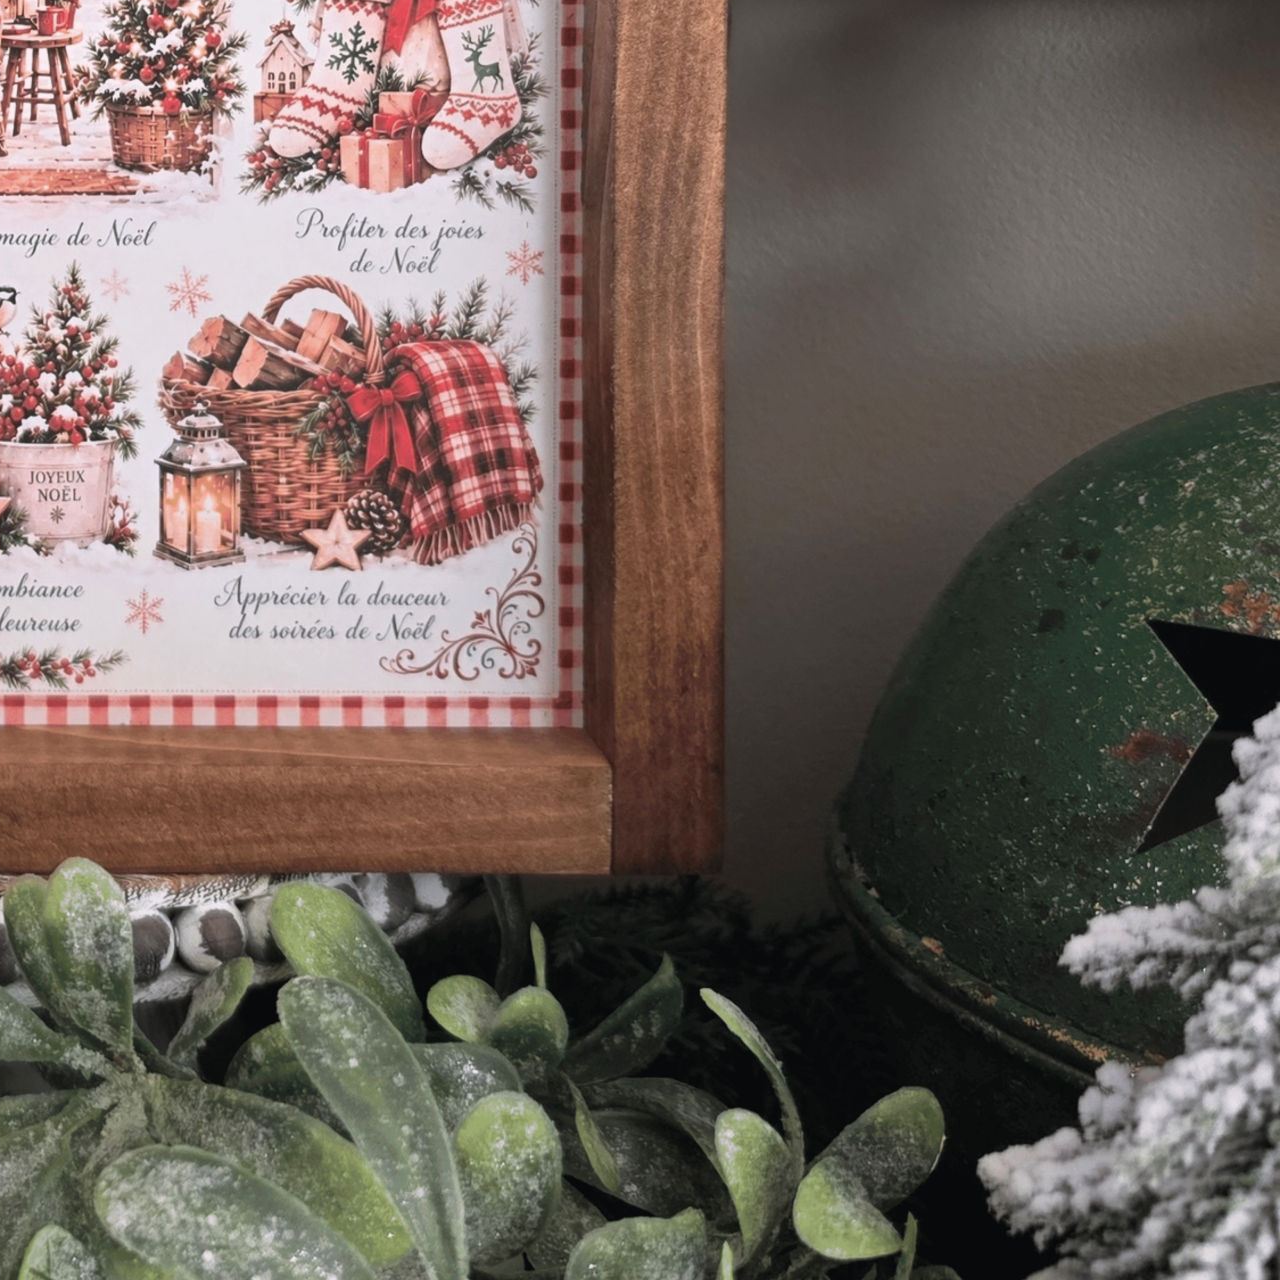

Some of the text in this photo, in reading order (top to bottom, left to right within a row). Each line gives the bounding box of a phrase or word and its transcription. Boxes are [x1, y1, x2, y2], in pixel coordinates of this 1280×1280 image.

[67, 221, 92, 246] de
[97, 218, 157, 247] Noël
[295, 208, 486, 251] Profiter des joies
[350, 246, 442, 274] de Noël
[28, 470, 85, 484] JOYEUX
[38, 485, 81, 502] NOËL
[214, 574, 450, 615] Apprécier la douceur
[228, 612, 436, 640] des soirées de Noël
